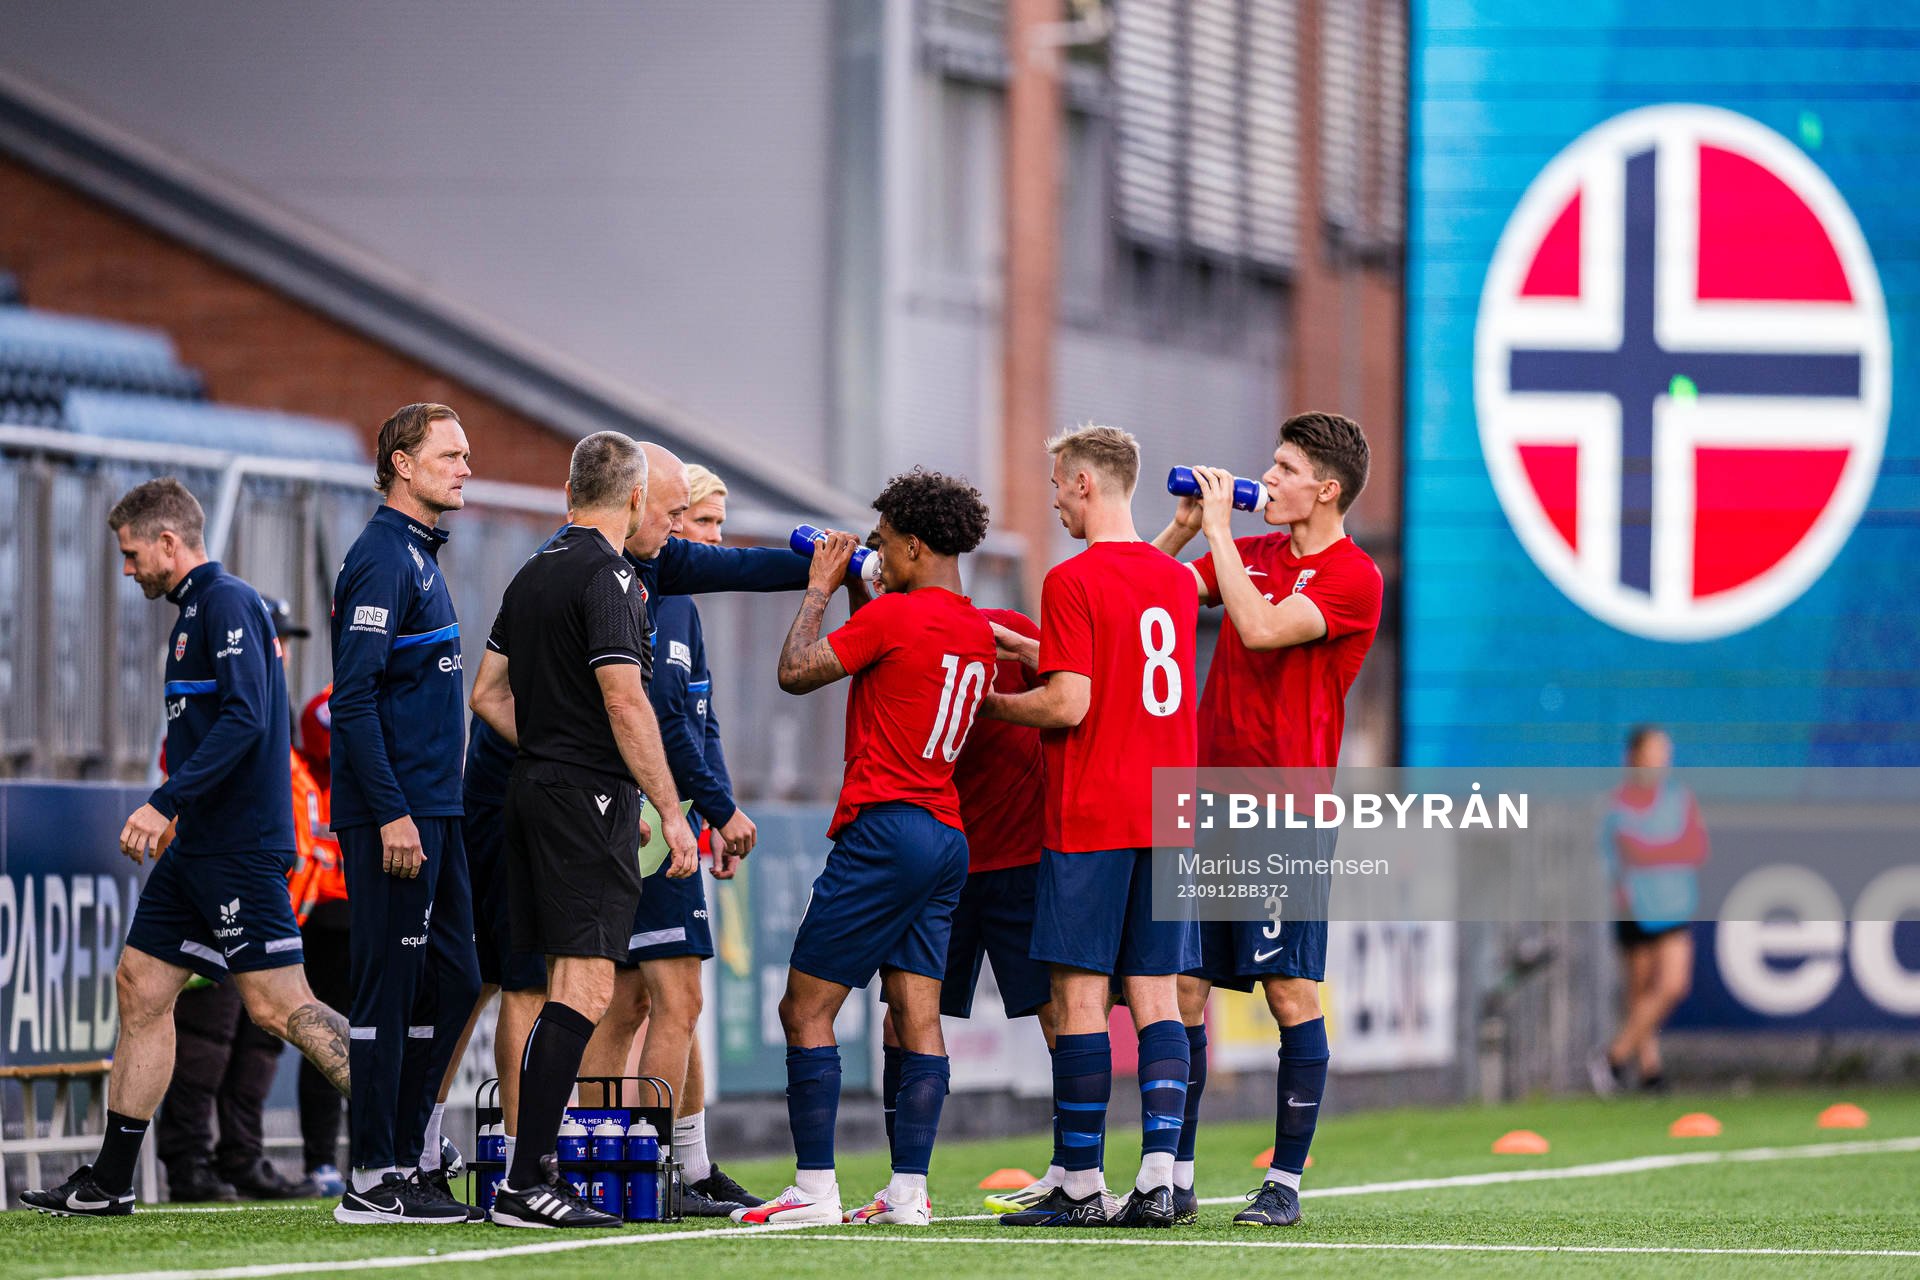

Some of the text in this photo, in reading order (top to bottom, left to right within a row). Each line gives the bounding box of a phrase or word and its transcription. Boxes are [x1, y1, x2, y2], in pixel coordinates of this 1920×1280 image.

[357, 610, 383, 624] DNB
[1139, 606, 1182, 717] 8
[922, 653, 986, 763] 10
[1262, 896, 1283, 939] 3
